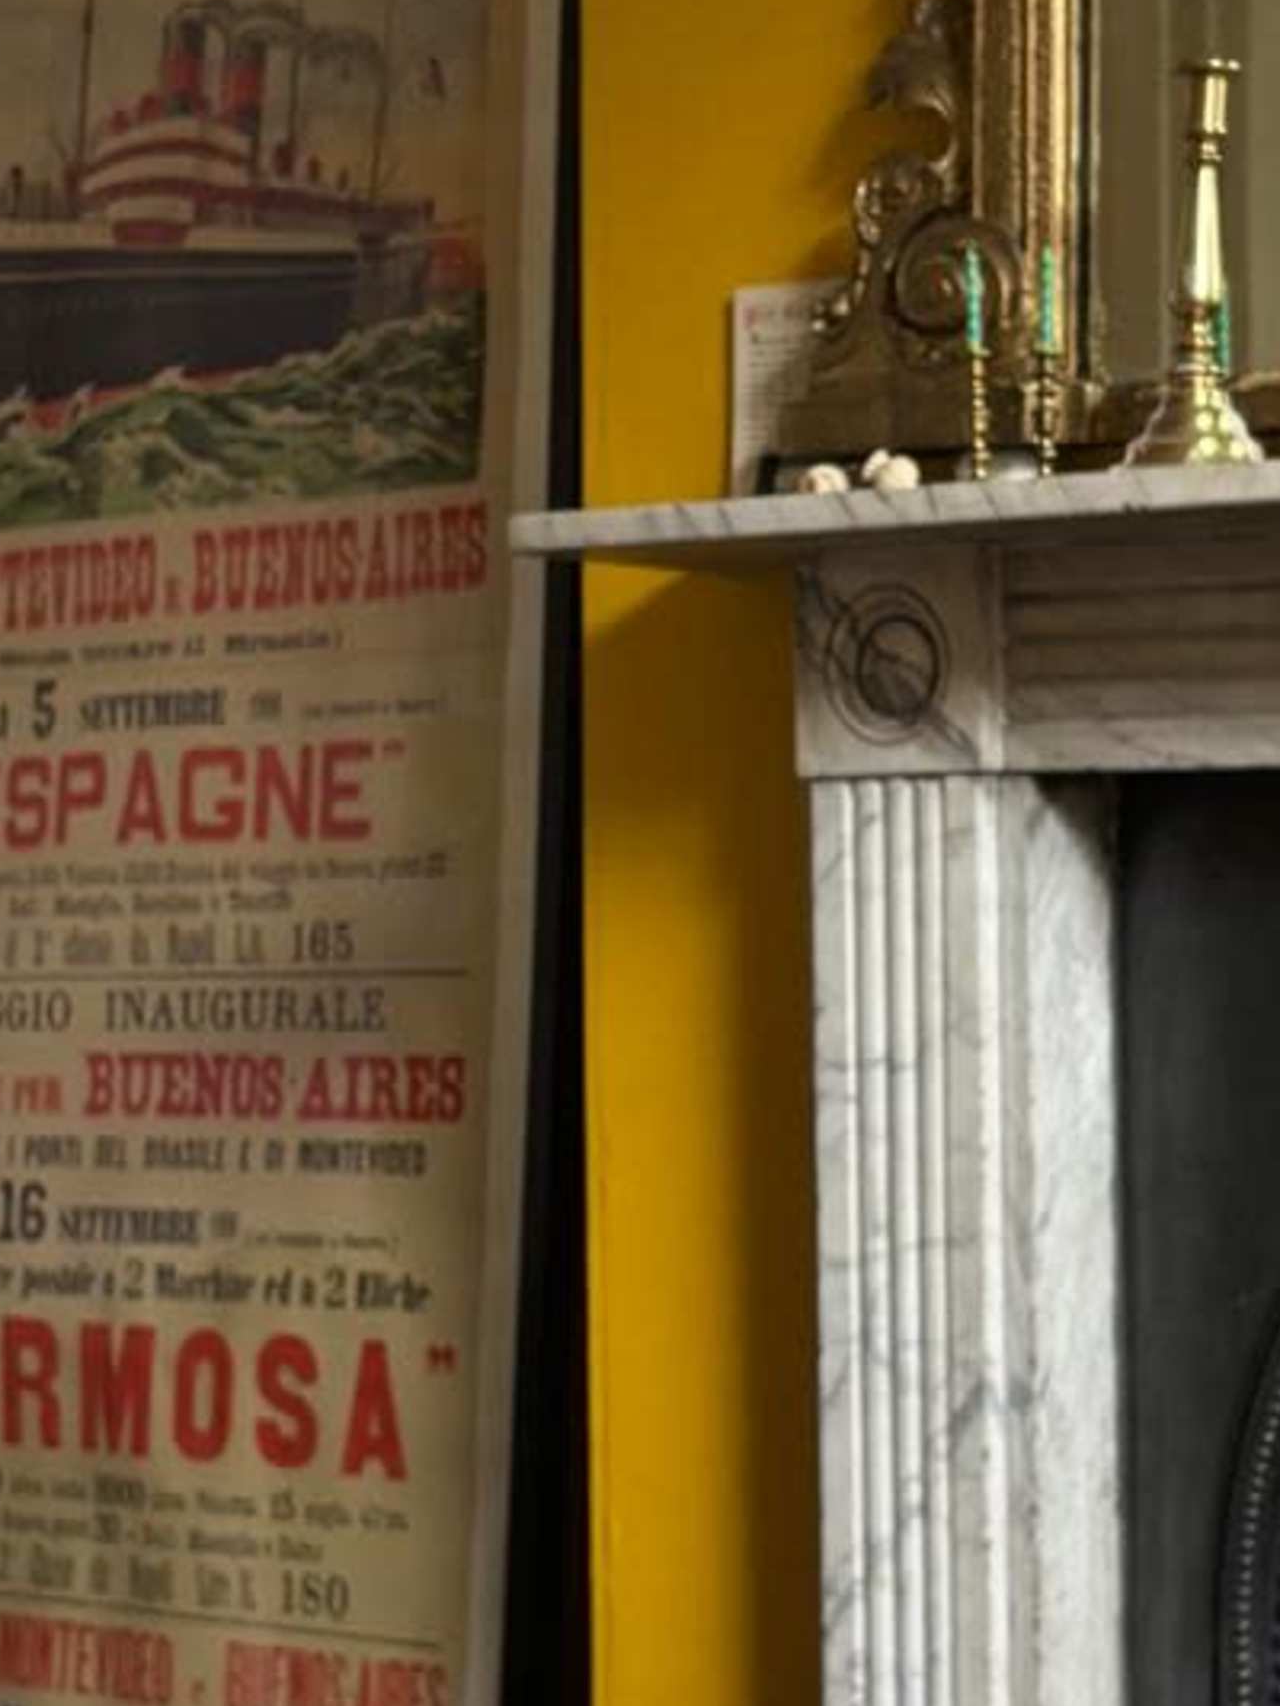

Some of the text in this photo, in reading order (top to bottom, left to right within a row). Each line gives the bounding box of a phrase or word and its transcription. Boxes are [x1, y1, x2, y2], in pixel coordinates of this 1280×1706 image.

[192, 516, 358, 615] BUENOS
[364, 500, 488, 601] AIRES
[32, 678, 58, 740] 5
[291, 919, 356, 965] 165
[104, 986, 387, 1033] INAUGURALE
[122, 1258, 146, 1300] 2
[323, 1266, 348, 1309] 2
[281, 1568, 352, 1622] 180
